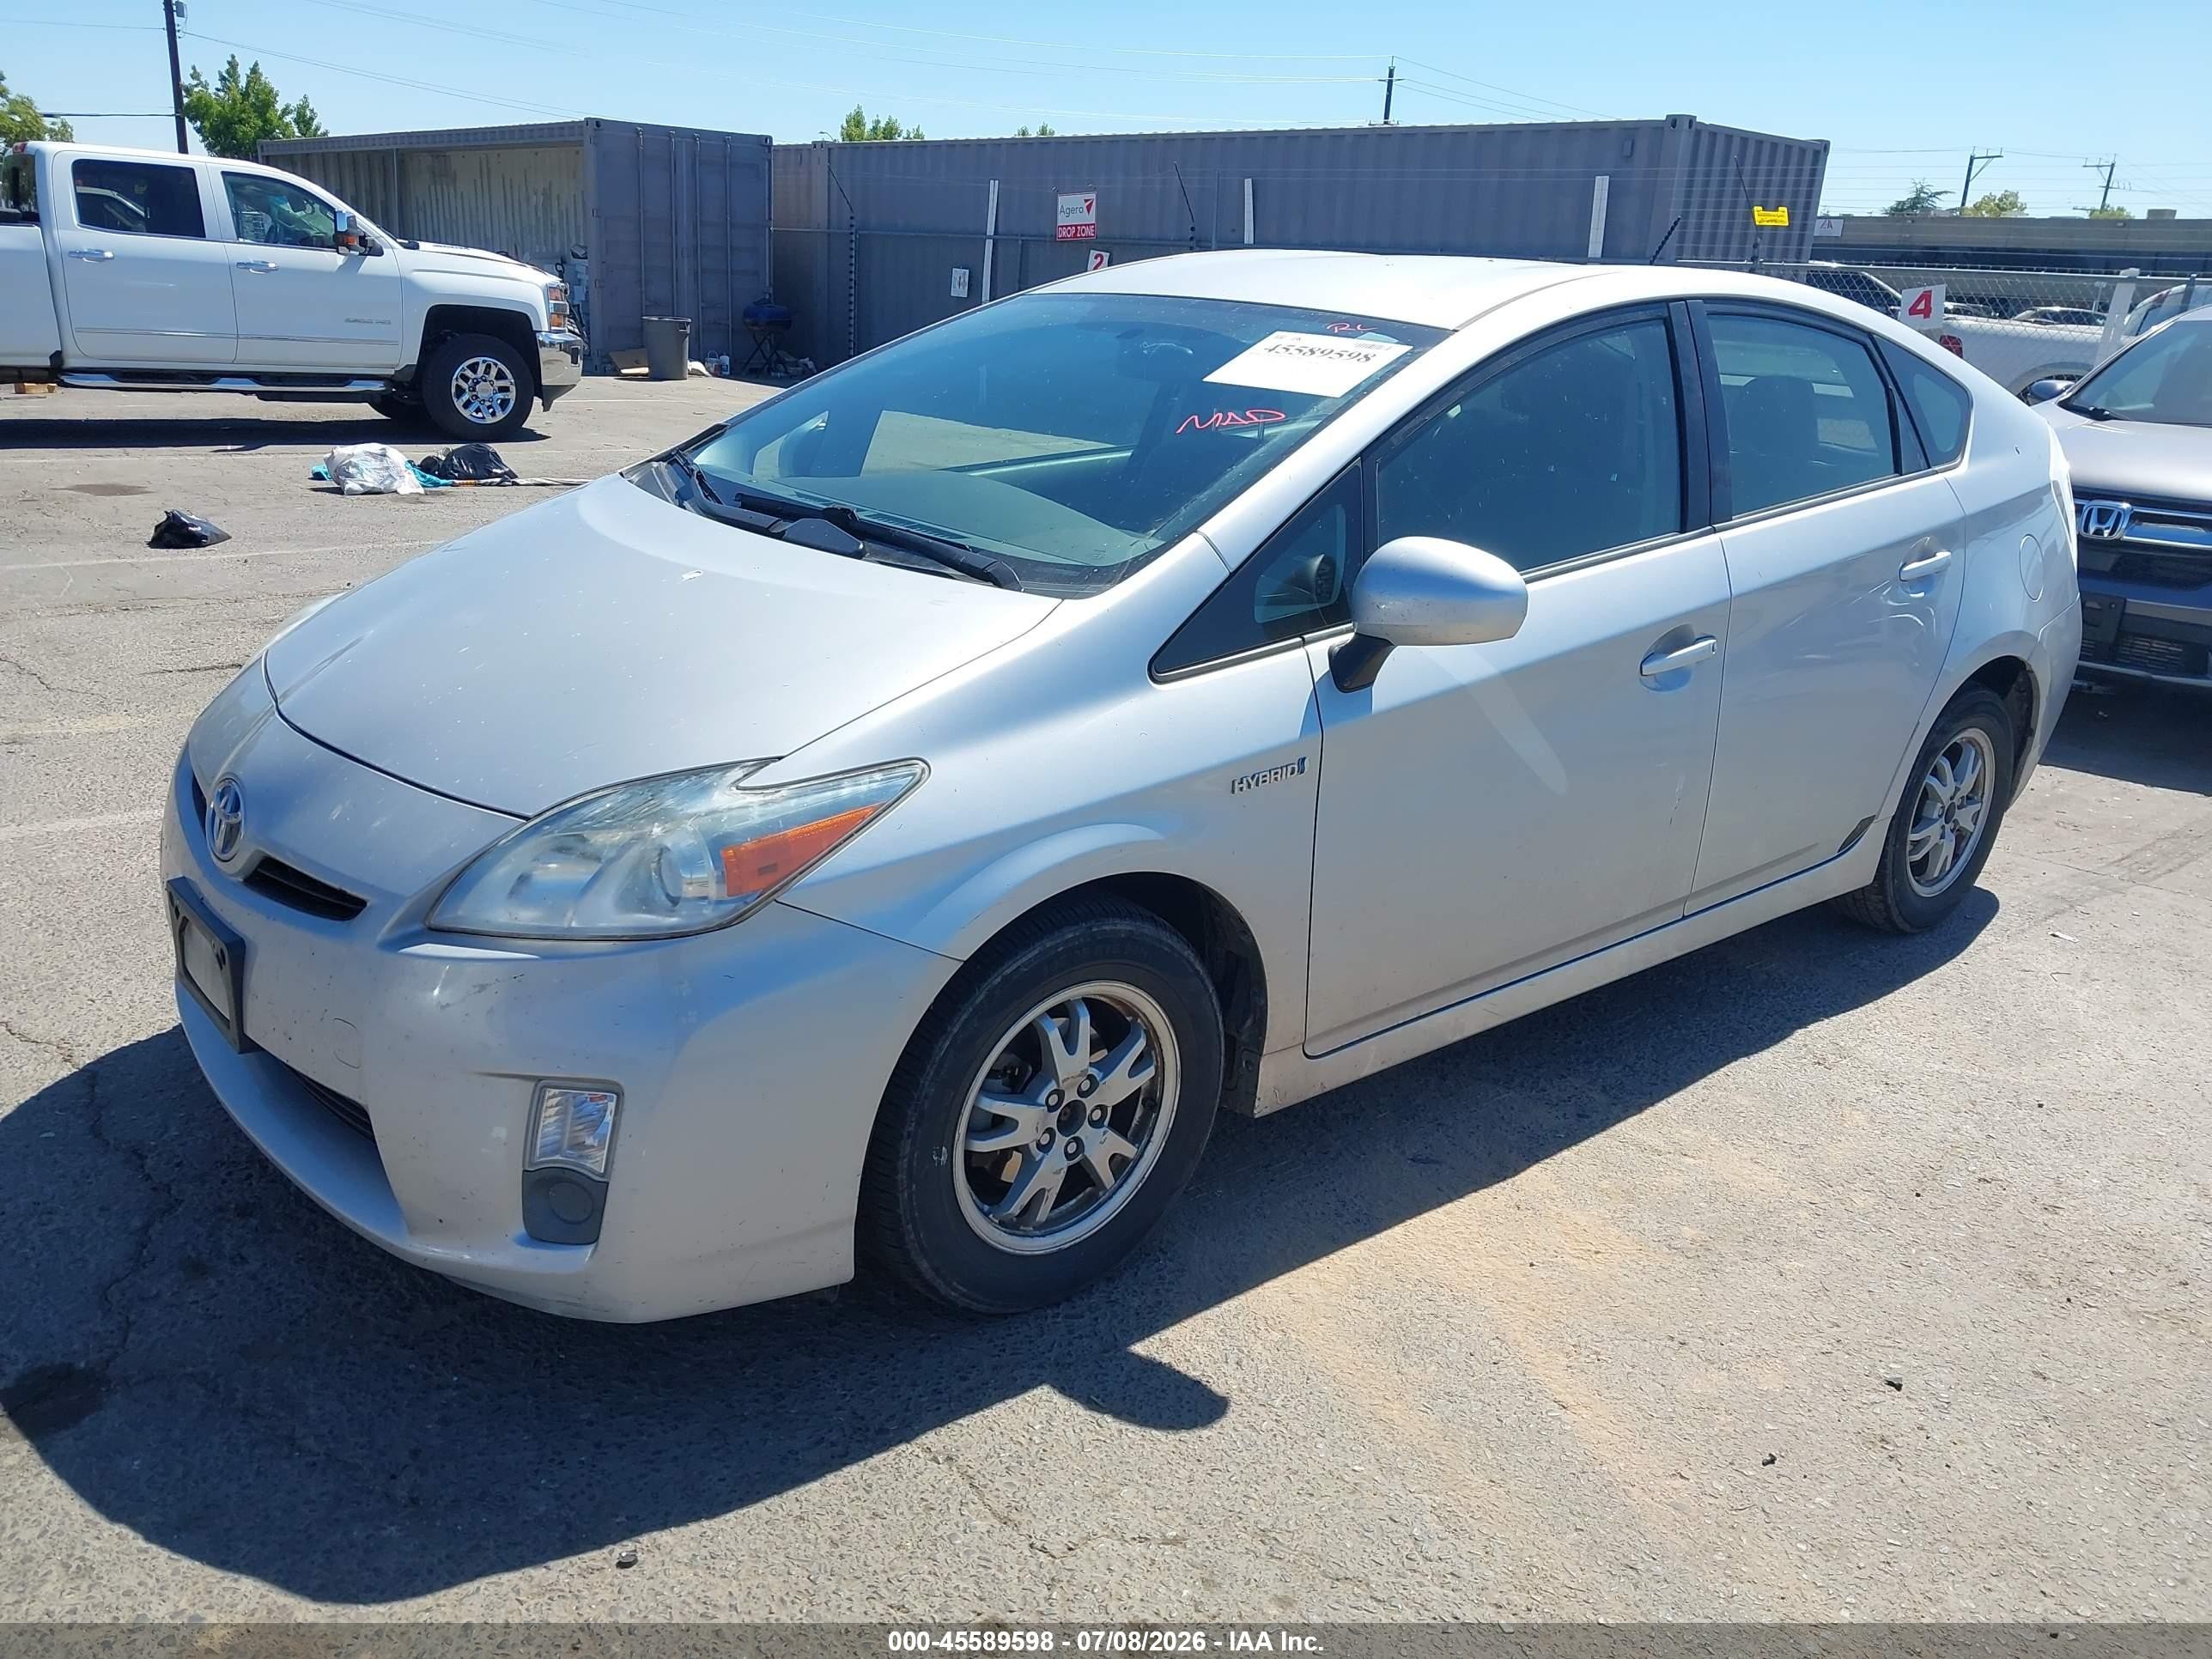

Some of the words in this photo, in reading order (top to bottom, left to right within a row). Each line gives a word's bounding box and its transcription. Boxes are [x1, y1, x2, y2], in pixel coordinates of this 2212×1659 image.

[1060, 204, 1084, 217] Agero
[1058, 226, 1076, 238] DROP
[1077, 225, 1095, 237] ZONE
[1093, 253, 1104, 270] 2
[1908, 289, 1933, 319] 4
[1264, 343, 1377, 363] 45589598
[1231, 763, 1298, 794] HYBRID
